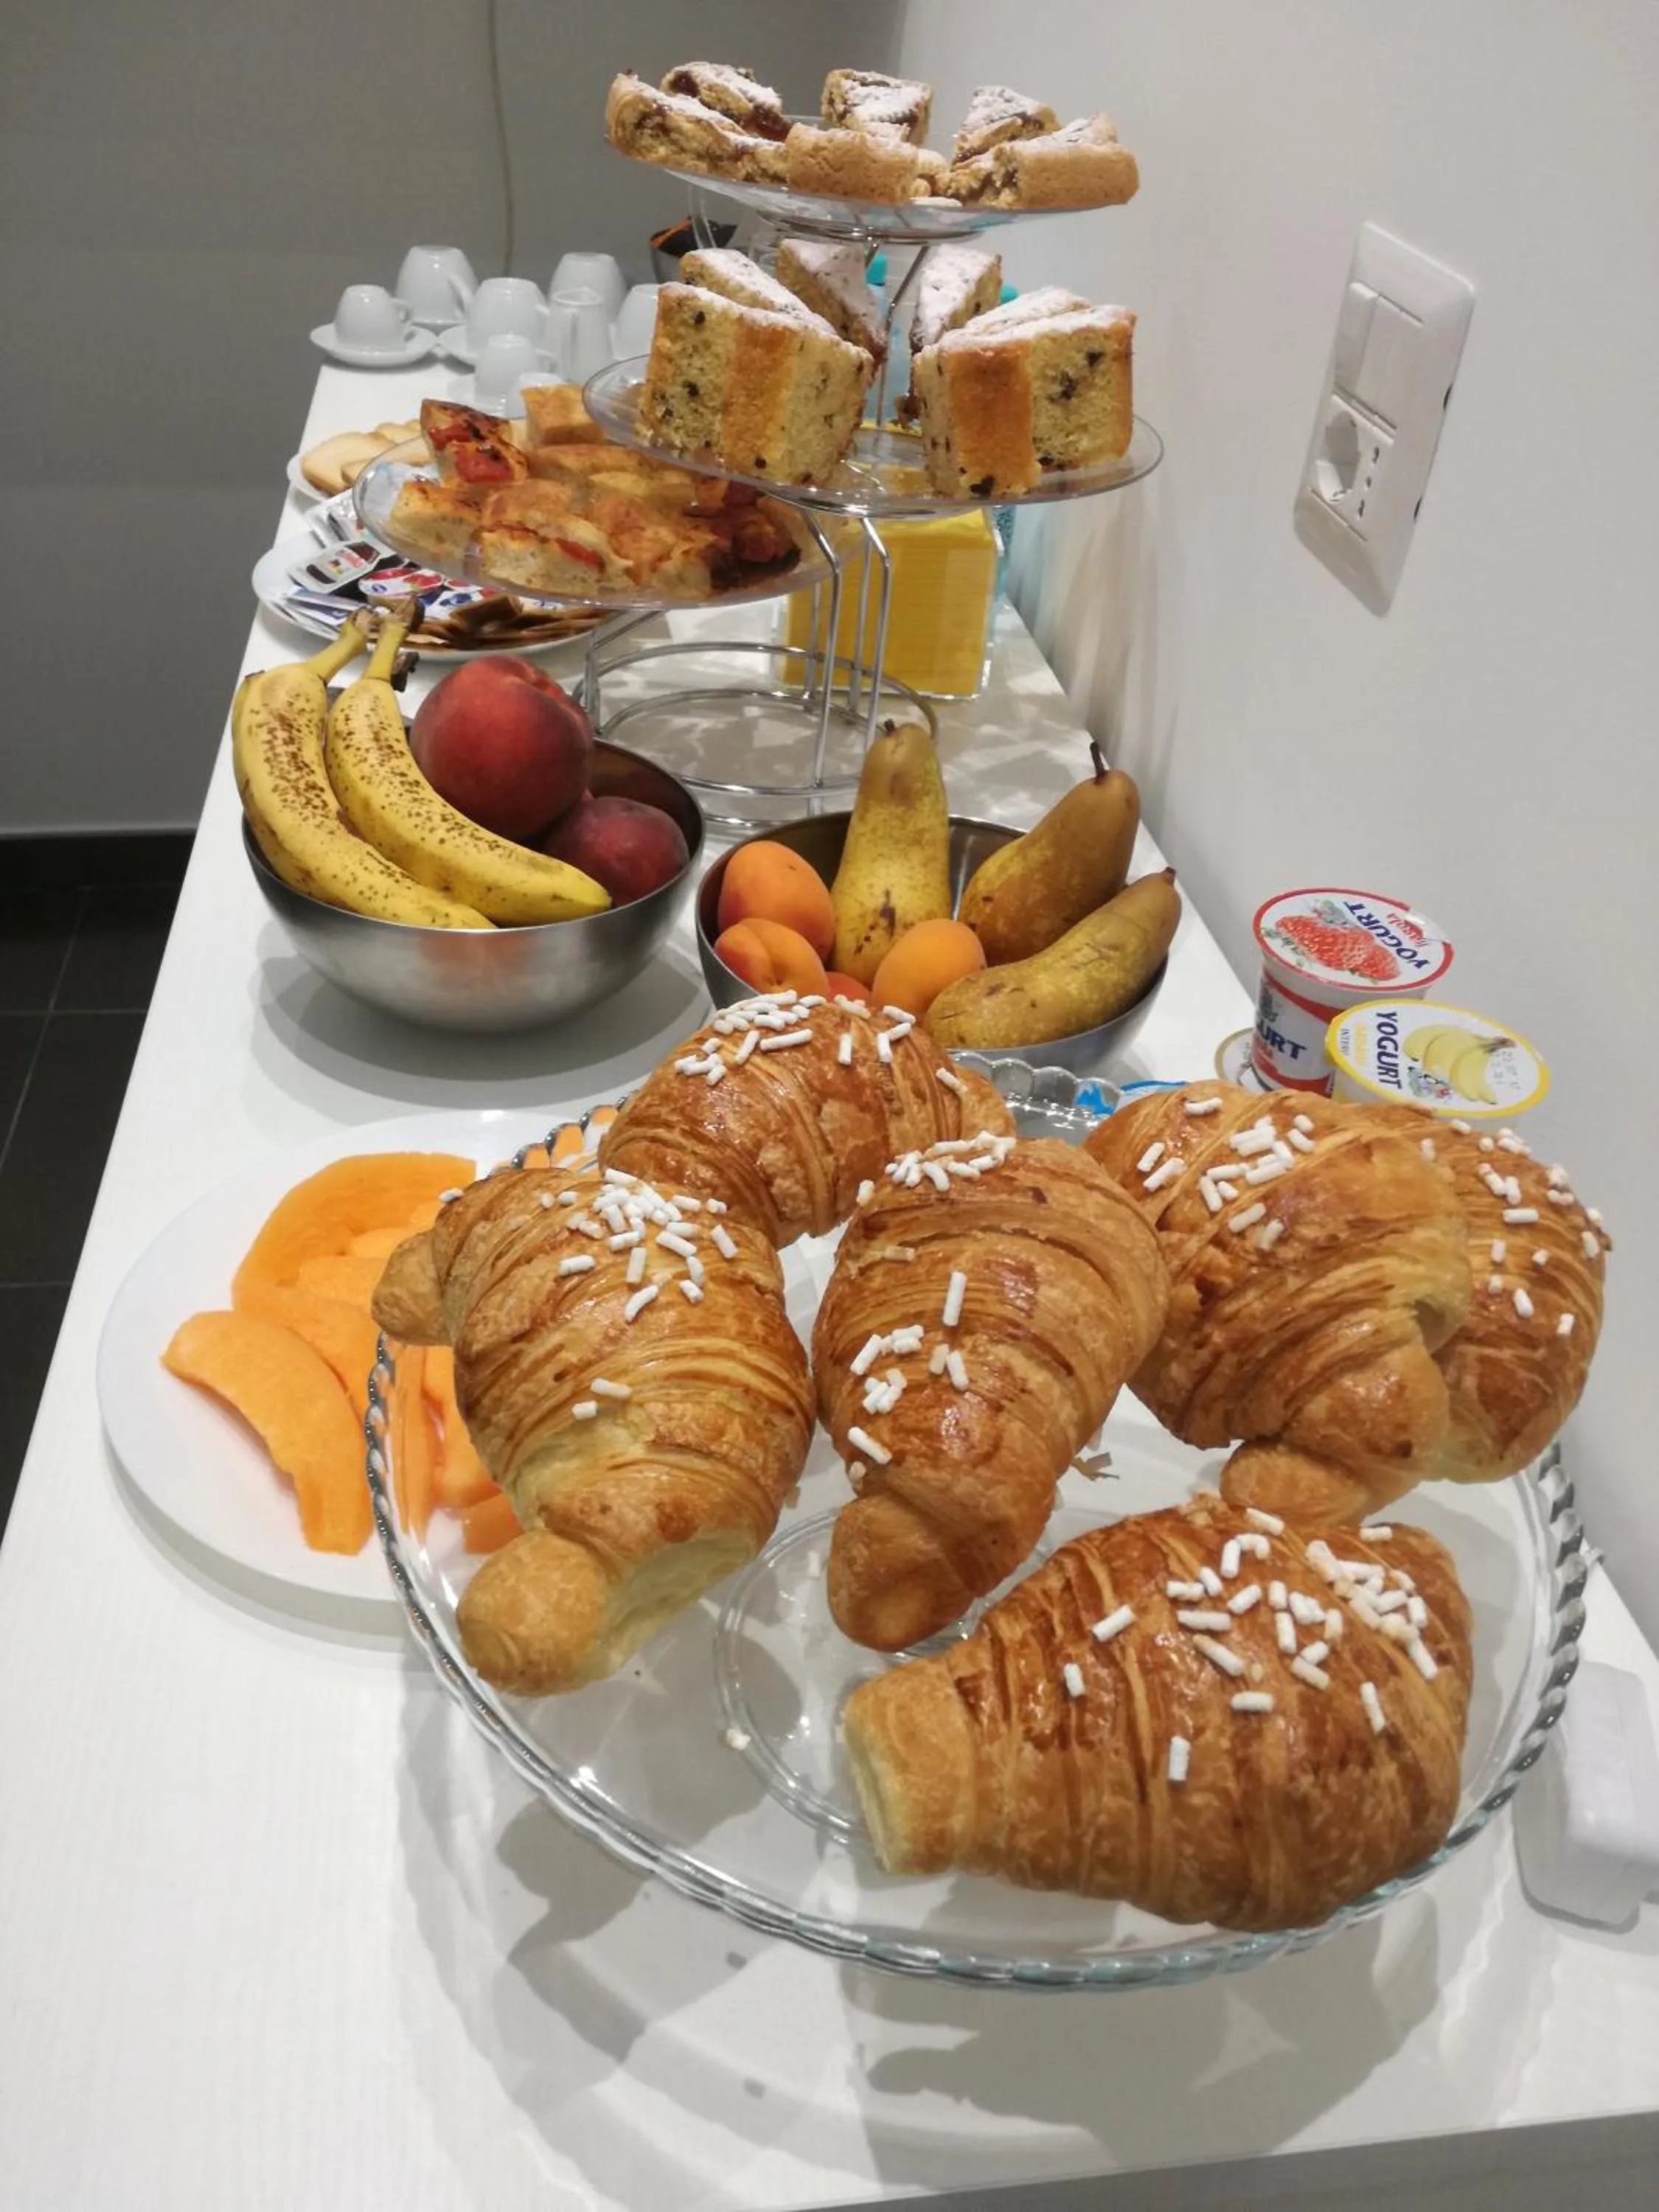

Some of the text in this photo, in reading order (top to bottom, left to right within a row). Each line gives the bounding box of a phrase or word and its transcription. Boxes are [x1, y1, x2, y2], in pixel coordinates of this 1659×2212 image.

[1343, 901, 1430, 969] YOGURT
[1256, 1018, 1307, 1060] URT
[1376, 1011, 1402, 1089] YOGURT
